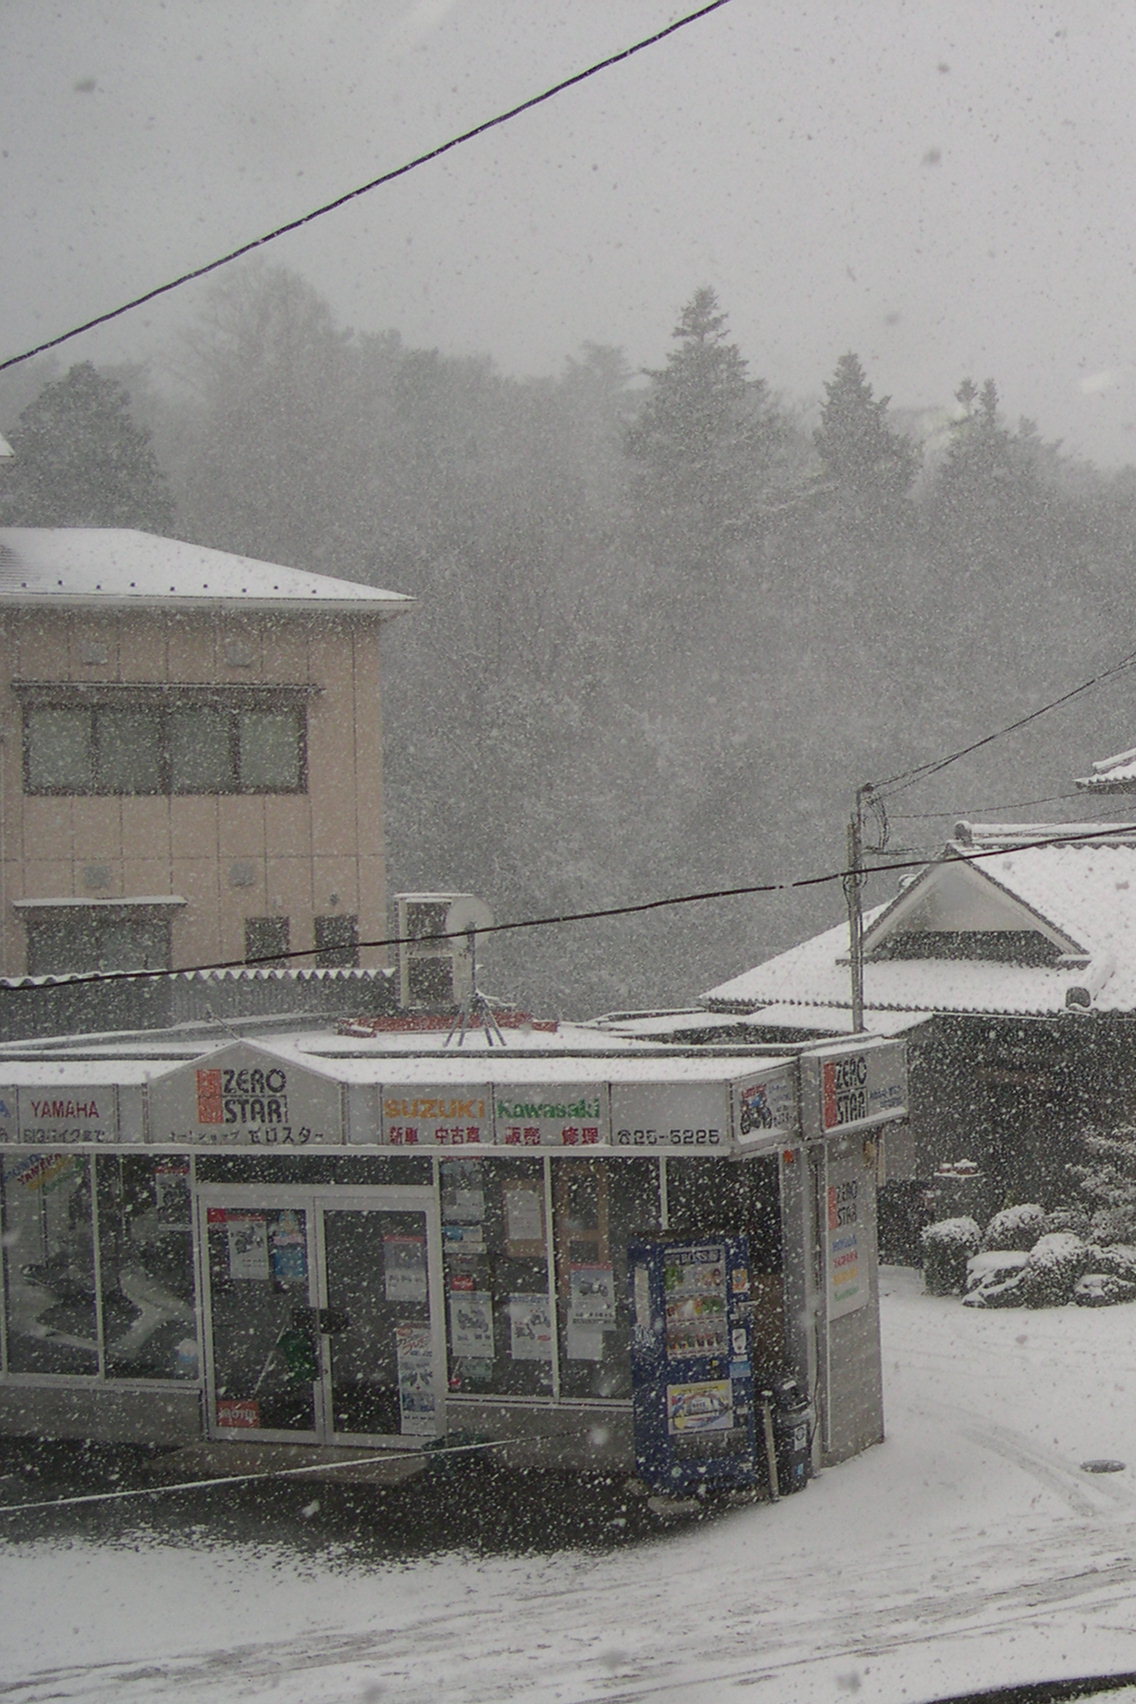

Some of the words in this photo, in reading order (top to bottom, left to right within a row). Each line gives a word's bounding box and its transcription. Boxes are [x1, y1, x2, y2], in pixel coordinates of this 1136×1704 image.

[223, 1068, 287, 1093] ZERO
[836, 1056, 868, 1089] ZERO
[30, 1100, 100, 1118] YAMAHA
[224, 1099, 283, 1123] STAR
[383, 1099, 486, 1119] SUZUKI
[497, 1098, 600, 1119] Kawasaki
[836, 1091, 866, 1124] STAR
[248, 1127, 325, 1145] ゼロスター
[389, 1127, 419, 1145] 新車
[434, 1127, 481, 1145] 中古車
[505, 1127, 541, 1145] 販売
[561, 1127, 600, 1145] 修理
